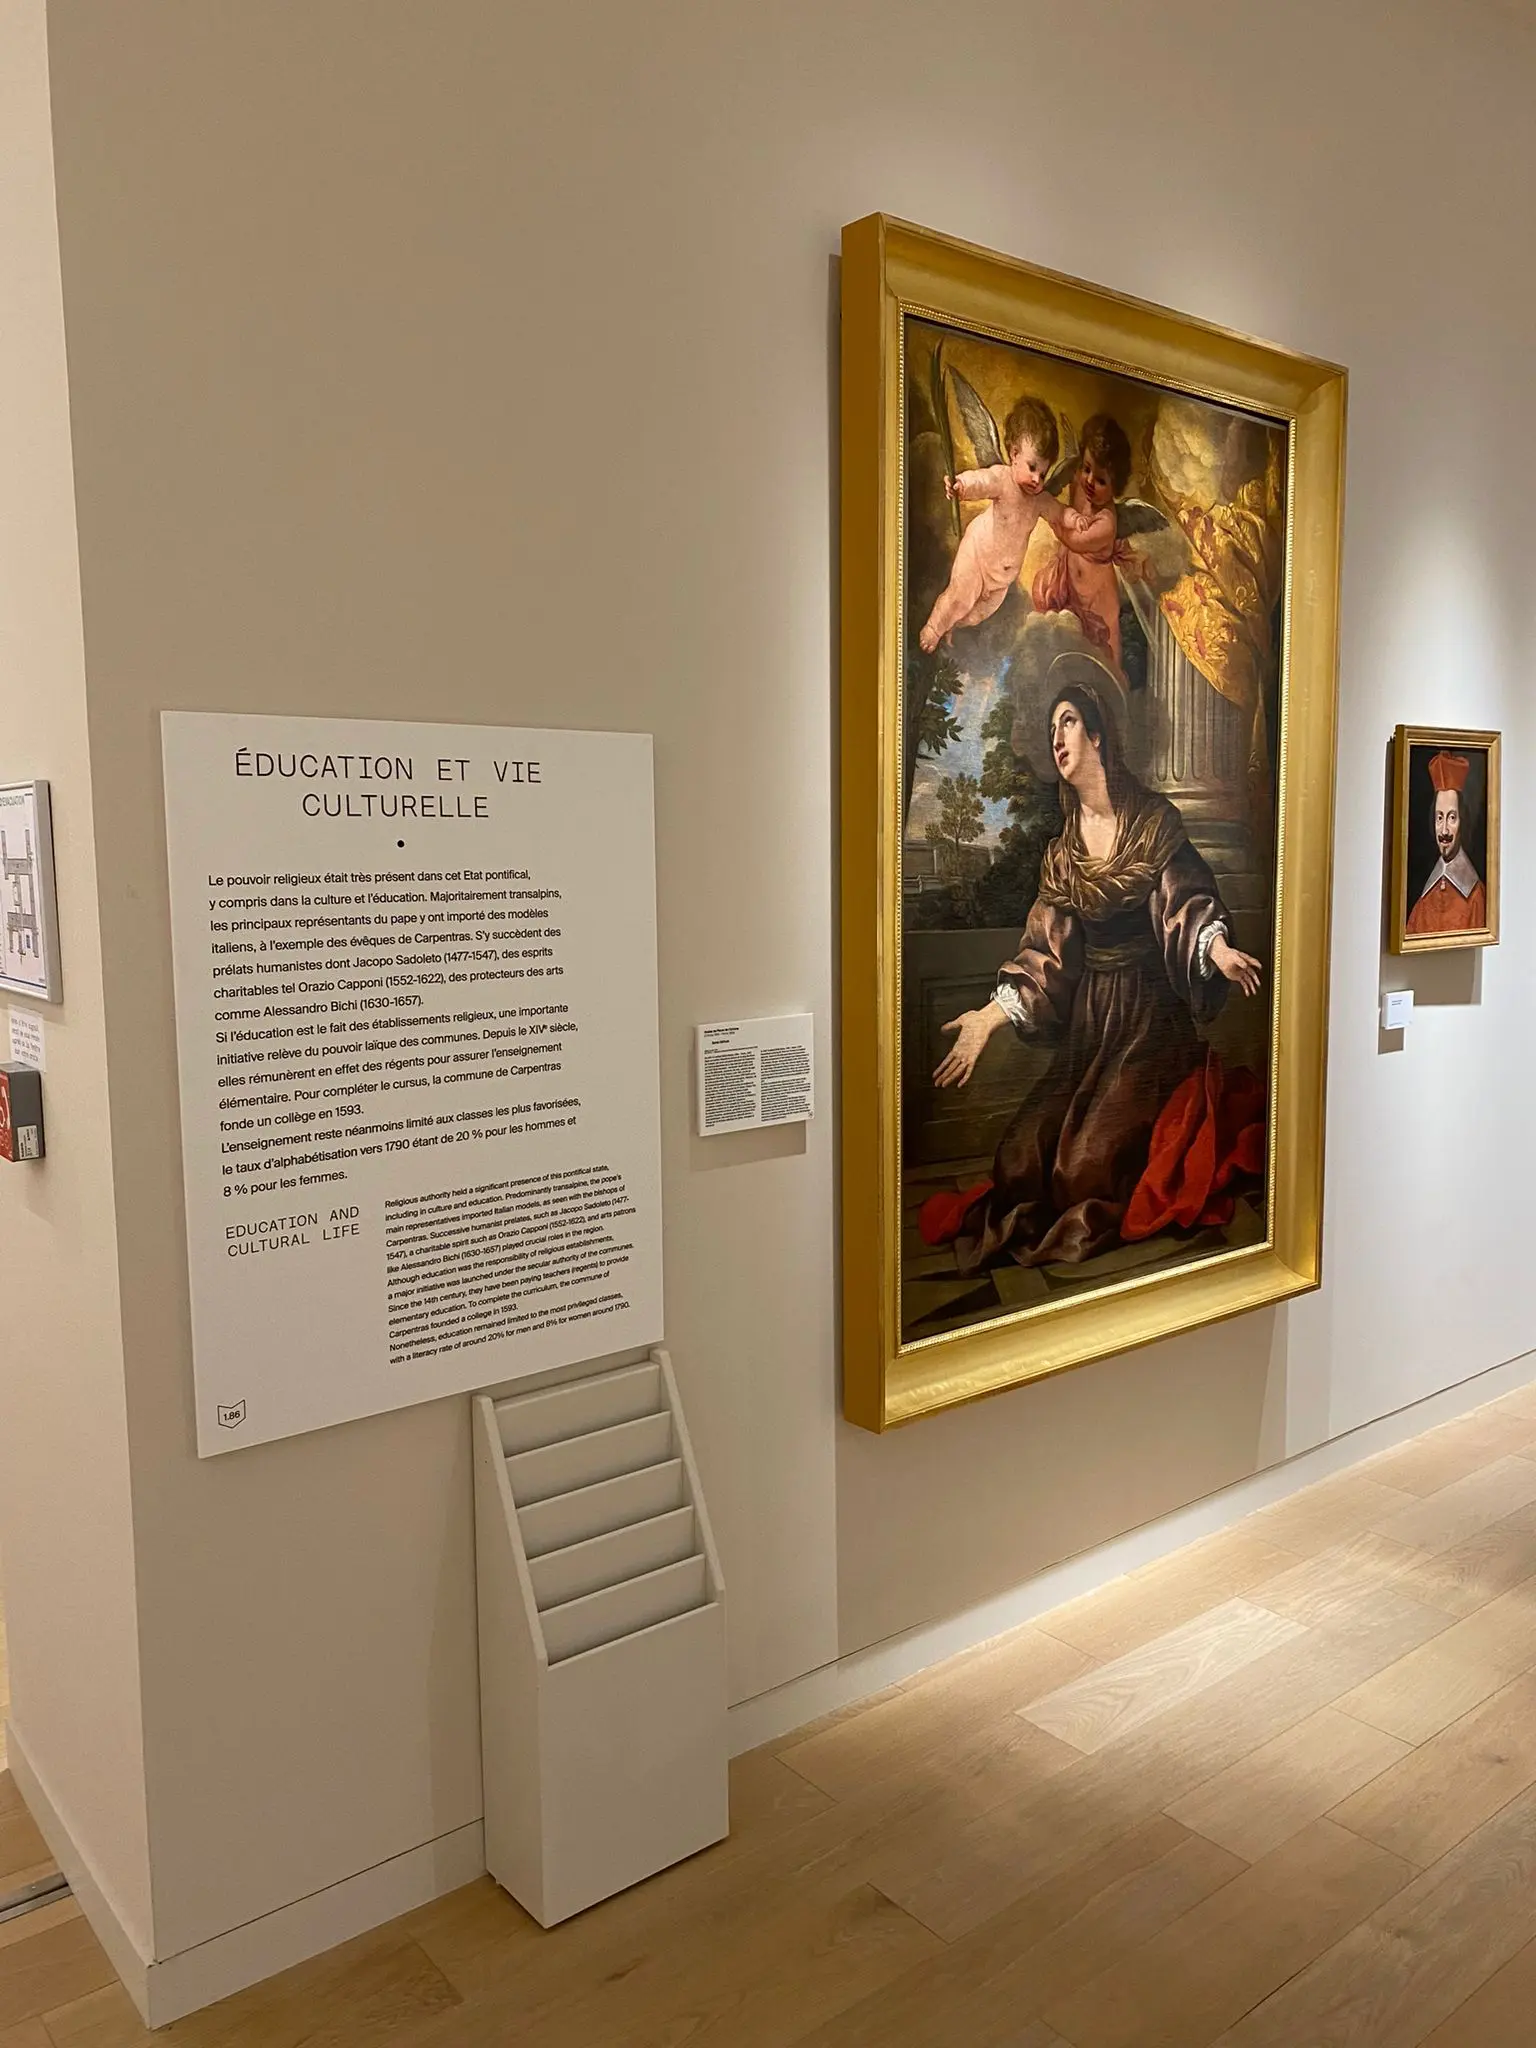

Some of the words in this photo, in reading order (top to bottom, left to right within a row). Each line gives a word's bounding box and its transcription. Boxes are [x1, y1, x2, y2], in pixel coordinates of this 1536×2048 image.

[235, 747, 412, 779] ÉDUCATION
[437, 759, 470, 780] ET
[493, 761, 541, 783] VIE
[302, 793, 488, 817] CULTURELLE
[208, 875, 223, 885] Le
[227, 874, 270, 887] pouvoir
[273, 873, 321, 886] religieux
[324, 872, 348, 883] était
[350, 872, 371, 882] très
[374, 871, 415, 884] présent
[417, 871, 442, 881] dans
[444, 871, 461, 880] cet
[463, 870, 482, 880] Etat
[485, 869, 530, 881] pontifical,
[209, 900, 215, 910] y
[218, 896, 267, 909] compris
[270, 896, 298, 906] dans
[301, 895, 311, 905] la
[313, 894, 351, 905] culture
[354, 894, 365, 904] et
[430, 890, 506, 903] Majoritairement
[509, 888, 561, 900] transalpins,
[210, 920, 228, 930] les
[231, 918, 292, 932] principaux
[294, 915, 371, 929] représentants
[374, 914, 387, 924] du
[390, 914, 417, 925] pape
[419, 914, 425, 924] y
[427, 912, 444, 922] ont
[446, 910, 485, 922] importé
[487, 910, 505, 919] des
[507, 908, 548, 918] modèles
[213, 964, 253, 978] prélats
[256, 960, 322, 973] humanistes
[325, 958, 350, 969] dont
[352, 957, 393, 967] Jacopo
[395, 953, 441, 965] Sadoleto
[443, 949, 499, 964] (1477-1547),
[501, 949, 519, 958] des
[521, 947, 552, 958] esprits
[213, 984, 278, 998] charitables
[281, 982, 295, 993] tel
[298, 980, 334, 992] Orazio
[337, 977, 383, 990] Capponi
[385, 972, 446, 988] (1552-1622),
[448, 972, 467, 982] des
[469, 969, 524, 982] protecteurs
[526, 967, 544, 976] des
[546, 966, 563, 975] arts
[214, 1009, 260, 1020] comme
[263, 1002, 328, 1016] Alessandro
[330, 999, 357, 1011] Bichi
[360, 995, 423, 1011] (1630-1657).
[216, 1031, 227, 1043] Si
[296, 1025, 314, 1035] est
[316, 1024, 326, 1034] le
[329, 1022, 346, 1032] fait
[349, 1020, 369, 1031] des
[372, 1014, 450, 1029] établissements
[453, 1011, 496, 1022] religieux,
[498, 1009, 516, 1018] une
[518, 1004, 568, 1016] importante
[217, 1051, 264, 1065] initiative
[267, 1048, 301, 1060] relève
[304, 1046, 318, 1056] du
[322, 1041, 362, 1056] pouvoir
[365, 1039, 396, 1051] laïque
[399, 1037, 418, 1047] des
[421, 1032, 480, 1045] communes.
[482, 1027, 516, 1039] Depuis
[518, 1026, 526, 1035] le
[549, 1022, 578, 1032] siècle,
[219, 1092, 291, 1109] élémentaire.
[294, 1090, 320, 1100] Pour
[322, 1082, 378, 1097] compléter
[380, 1080, 390, 1090] le
[392, 1077, 430, 1089] cursus,
[432, 1075, 441, 1084] la
[443, 1070, 493, 1083] commune
[495, 1067, 508, 1077] de
[510, 1062, 561, 1075] Carpentras
[220, 1118, 254, 1131] fonde
[257, 1117, 271, 1126] un
[274, 1111, 315, 1124] collège
[318, 1110, 332, 1119] en
[335, 1104, 363, 1116] 1593.
[314, 1129, 342, 1140] reste
[345, 1121, 404, 1136] néanmoins
[406, 1115, 433, 1128] limité
[436, 1114, 454, 1124] aux
[456, 1109, 493, 1121] classes
[495, 1107, 509, 1116] les
[511, 1104, 531, 1116] plus
[533, 1098, 580, 1110] favorisées,
[223, 1186, 231, 1197] 8
[234, 1183, 247, 1195] %
[250, 1181, 277, 1194] pour
[280, 1178, 296, 1188] les
[299, 1171, 347, 1185] femmes.
[226, 1213, 317, 1239] EDUCATION
[329, 1206, 359, 1221] AND
[227, 1233, 310, 1256] CULTURAL
[323, 1223, 359, 1240] LIFE
[400, 1257, 441, 1270] Alessandro
[442, 1252, 460, 1262] Bichi
[502, 1240, 523, 1251] played
[524, 1235, 546, 1246] crucial
[547, 1233, 563, 1241] roles
[387, 1274, 420, 1286] Although
[421, 1267, 456, 1279] education
[472, 1261, 484, 1269] the
[485, 1252, 529, 1266] responsibility
[529, 1249, 536, 1257] of
[538, 1245, 564, 1255] religious
[388, 1311, 429, 1325] elementary
[477, 1294, 509, 1305] complete
[571, 1273, 602, 1284] commune
[389, 1324, 429, 1338] Carpentras
[430, 1316, 459, 1328] founded
[466, 1310, 492, 1320] college
[438, 1327, 472, 1340] education
[473, 1318, 506, 1332] remained
[507, 1313, 529, 1324] limited
[538, 1309, 548, 1317] the
[550, 1304, 566, 1314] most
[567, 1297, 597, 1311] privileged
[223, 1410, 241, 1421] 1.86
